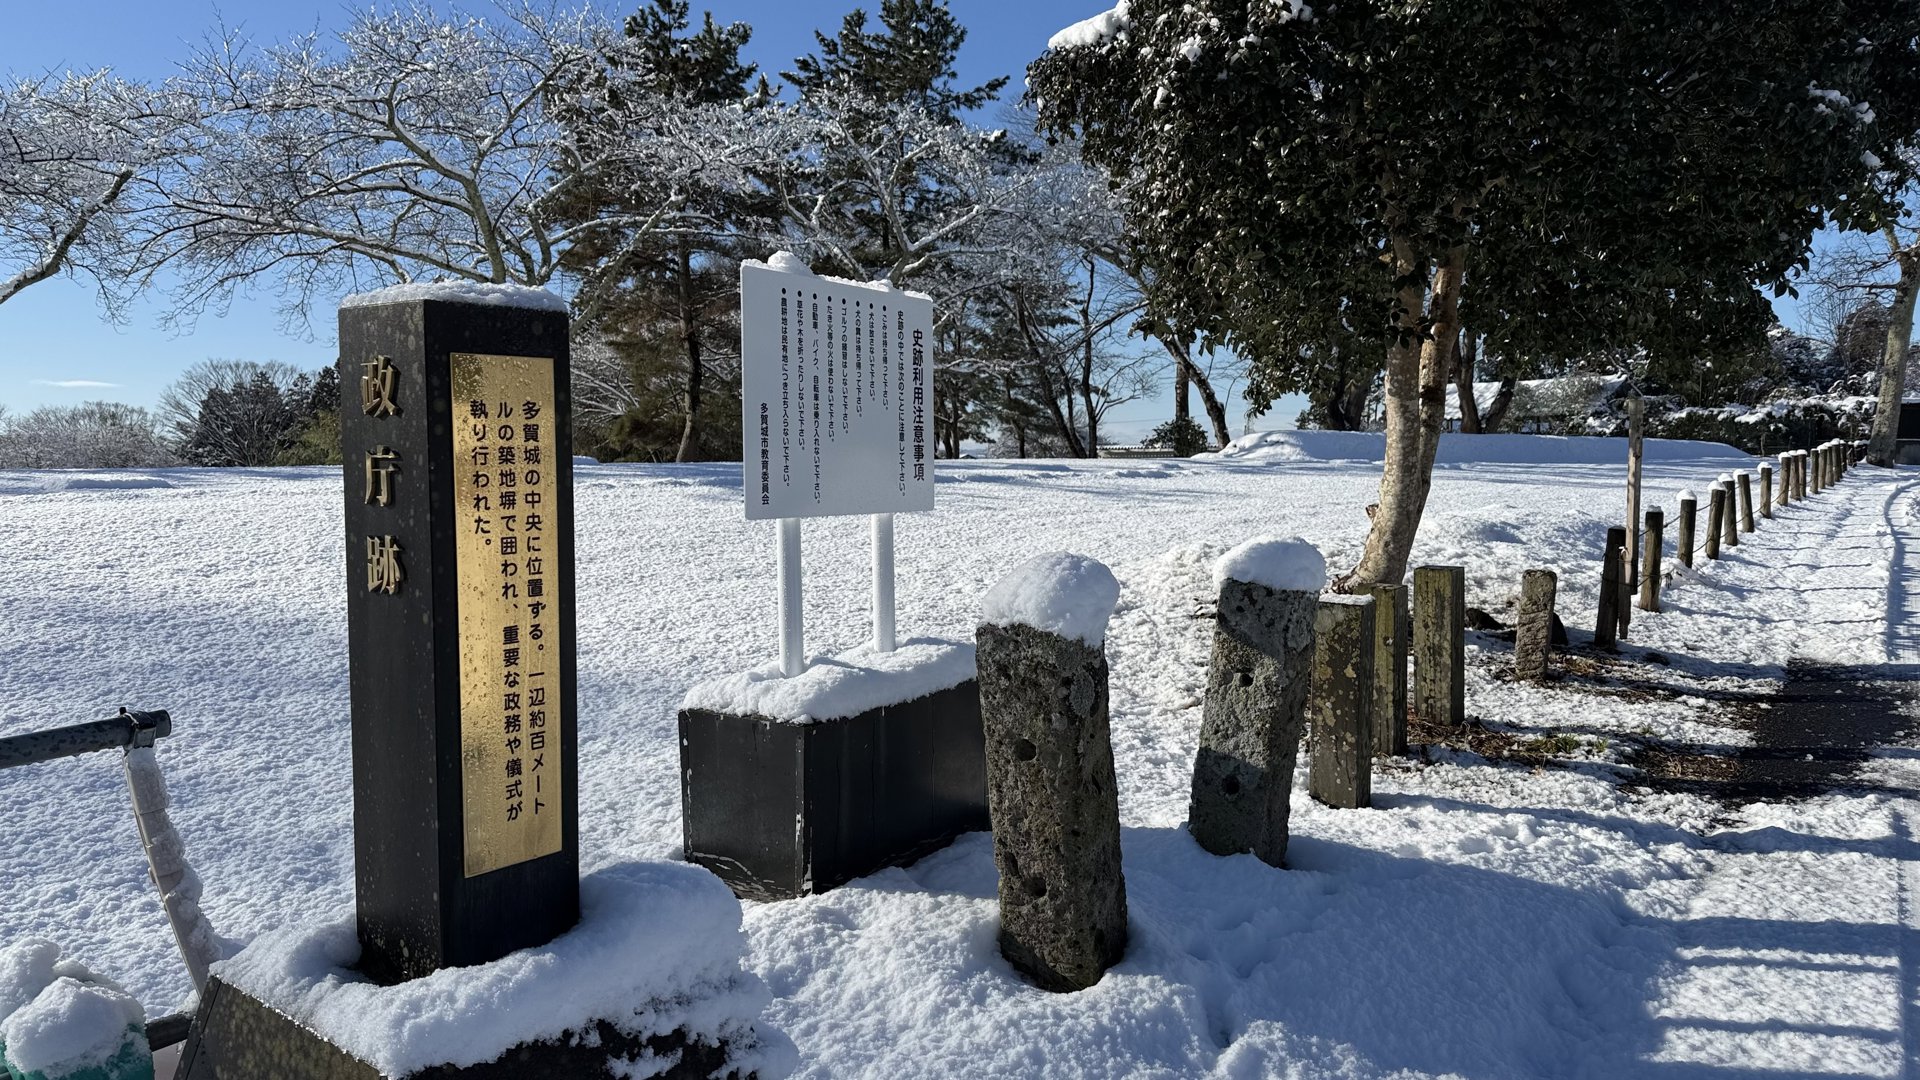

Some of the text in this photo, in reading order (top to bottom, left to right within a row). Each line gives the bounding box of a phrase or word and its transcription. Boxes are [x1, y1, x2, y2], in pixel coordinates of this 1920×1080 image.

[360, 354, 400, 595] 政庁跡
[470, 399, 492, 547] 執り行われた。
[760, 402, 770, 505] 多賀城市教育委員会
[912, 328, 925, 481] 史跡利用注意事項
[497, 401, 523, 821] ルの築地塀で囲われ、重要な政務や儀式が
